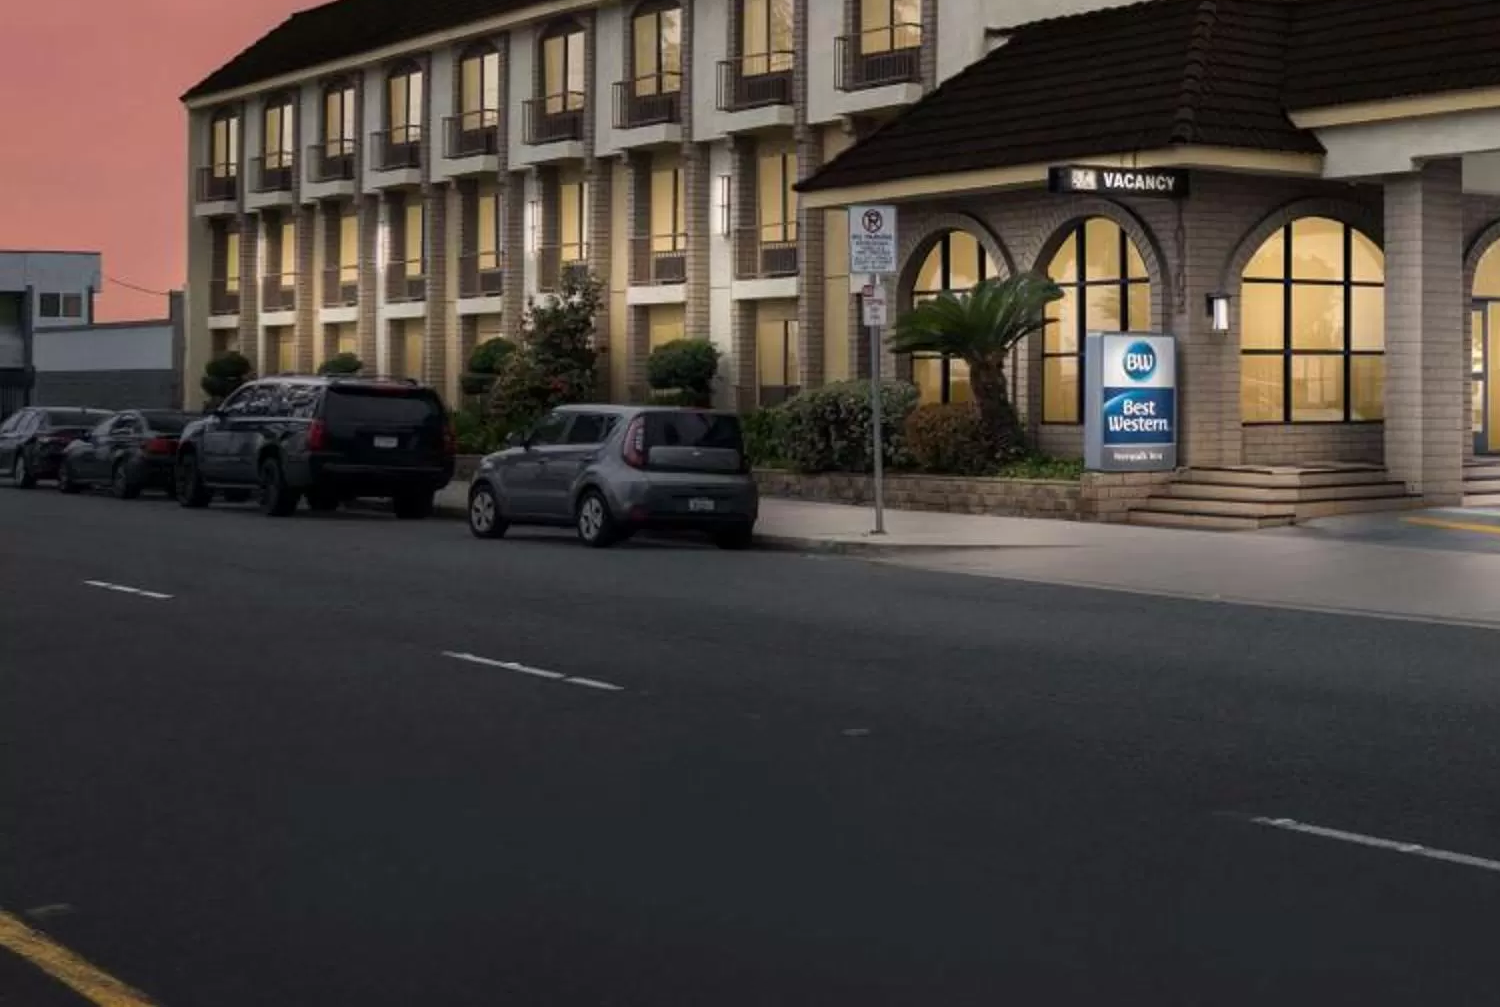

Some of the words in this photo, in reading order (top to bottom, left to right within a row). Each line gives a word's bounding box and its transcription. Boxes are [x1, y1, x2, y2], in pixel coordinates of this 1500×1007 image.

[1103, 171, 1176, 192] VACANCY
[1127, 353, 1154, 372] BW
[1123, 398, 1157, 416] Best
[1108, 415, 1169, 433] Western
